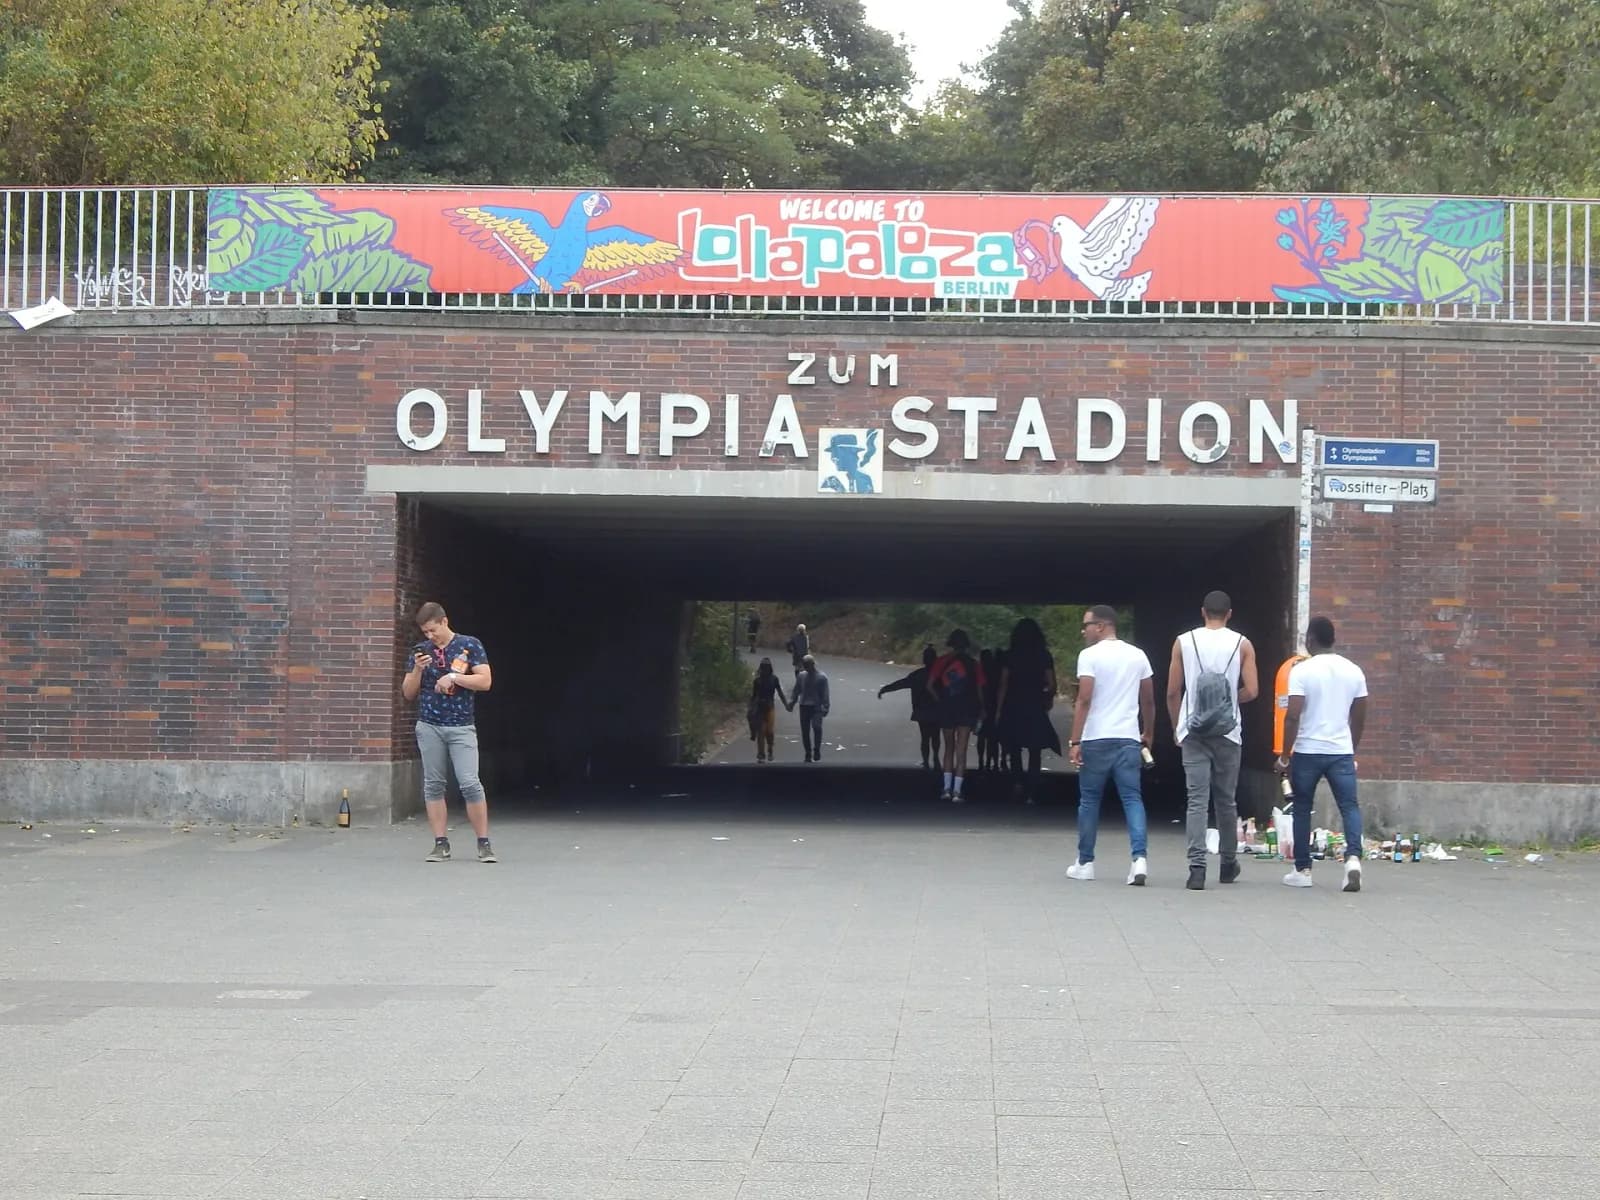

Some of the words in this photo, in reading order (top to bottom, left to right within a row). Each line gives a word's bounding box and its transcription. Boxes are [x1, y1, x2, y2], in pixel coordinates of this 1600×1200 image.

[780, 198, 885, 221] WELCOME
[894, 199, 925, 222] TO
[943, 281, 1010, 296] BERLIN
[787, 352, 898, 386] ZUM
[396, 387, 809, 458] OLYMPIA
[888, 396, 1298, 464] STADION
